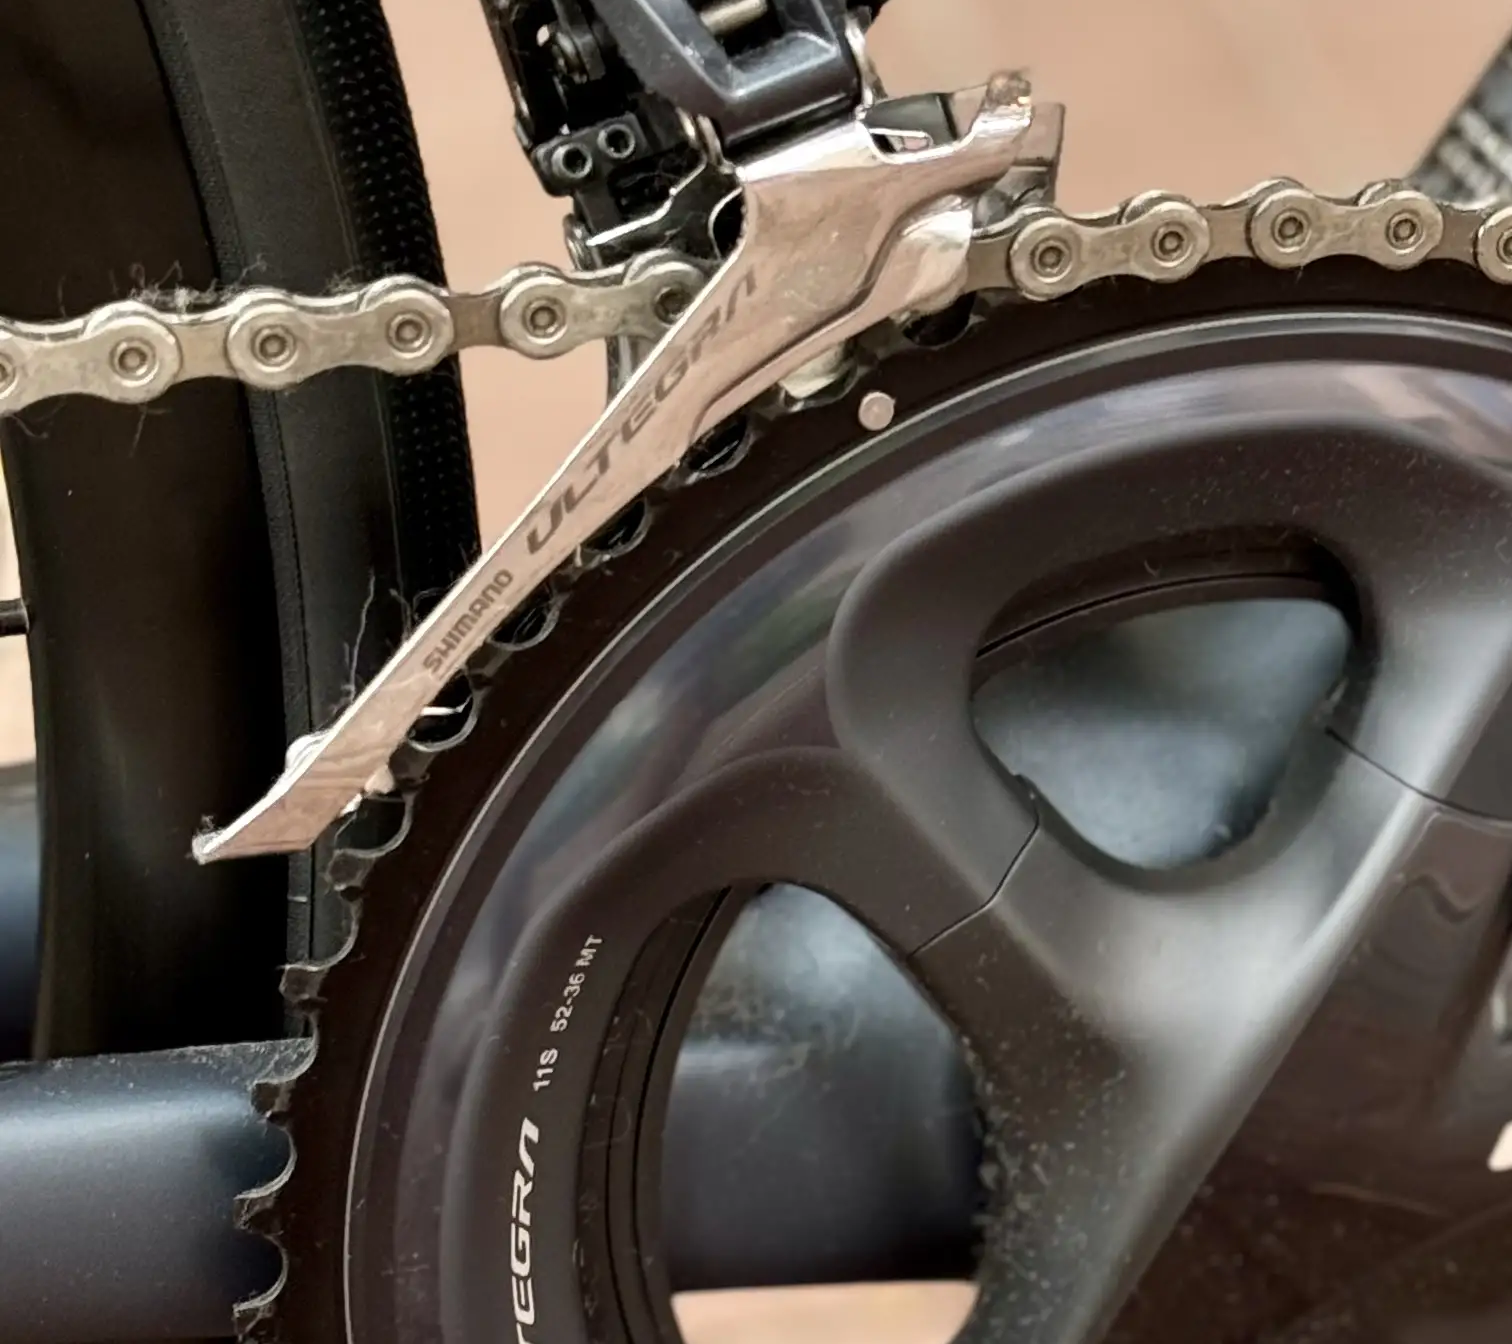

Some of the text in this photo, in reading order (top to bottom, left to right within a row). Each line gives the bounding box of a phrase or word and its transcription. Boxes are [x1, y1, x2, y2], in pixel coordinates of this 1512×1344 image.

[422, 268, 757, 675] SHIMANO ULTEGRA
[532, 1047, 559, 1092] 11S
[550, 972, 586, 1033] 52-36
[575, 934, 603, 967] MT
